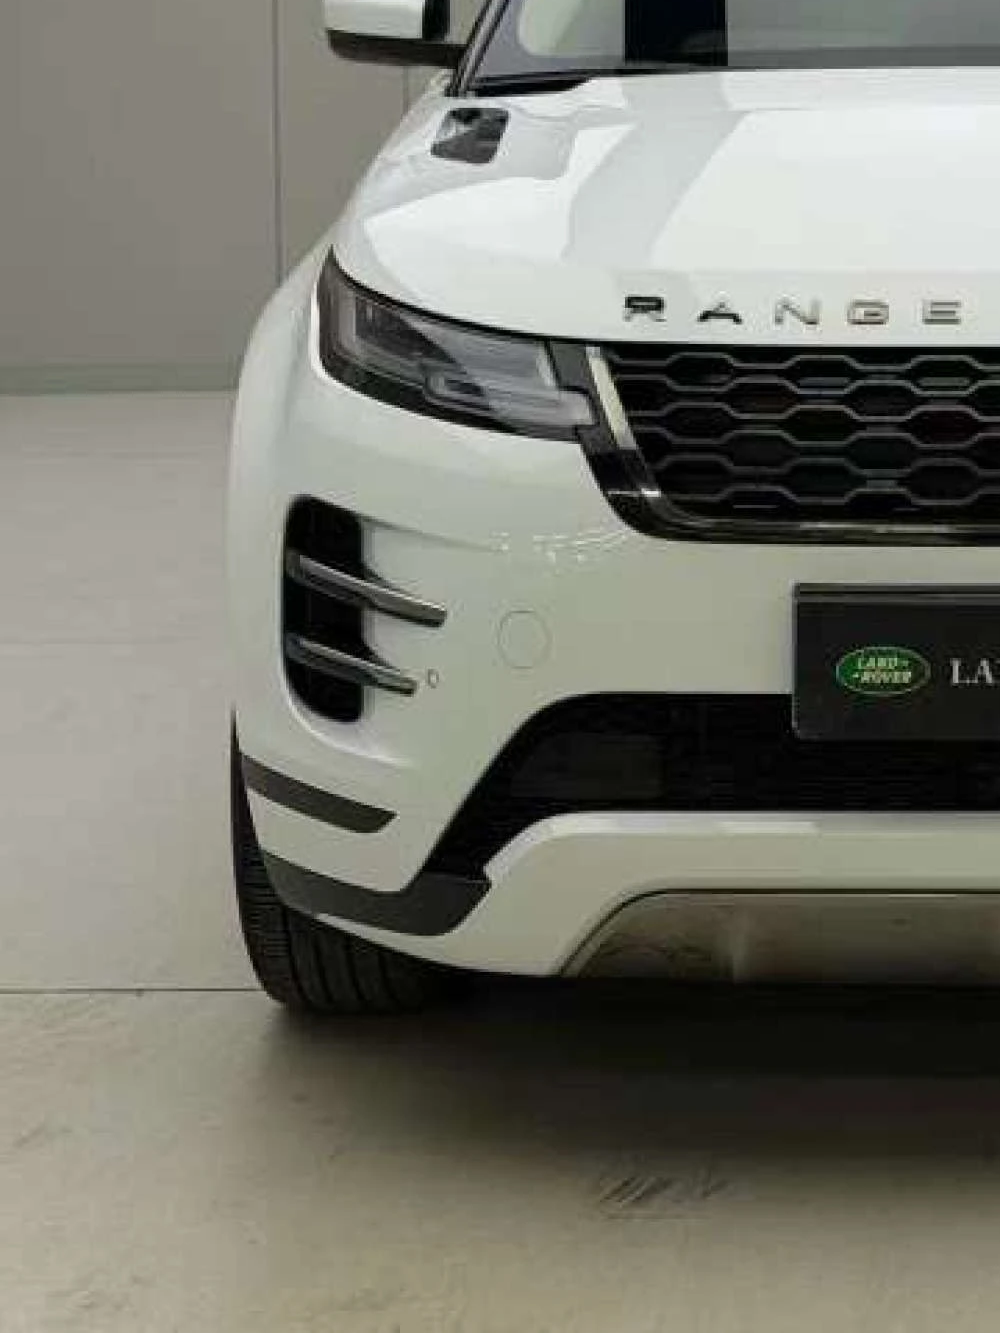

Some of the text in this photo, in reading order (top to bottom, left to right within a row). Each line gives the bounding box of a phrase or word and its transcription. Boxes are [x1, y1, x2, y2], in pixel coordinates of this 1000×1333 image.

[624, 296, 961, 325] RANGE
[857, 657, 898, 670] LAND
[860, 671, 912, 684] ROVER
